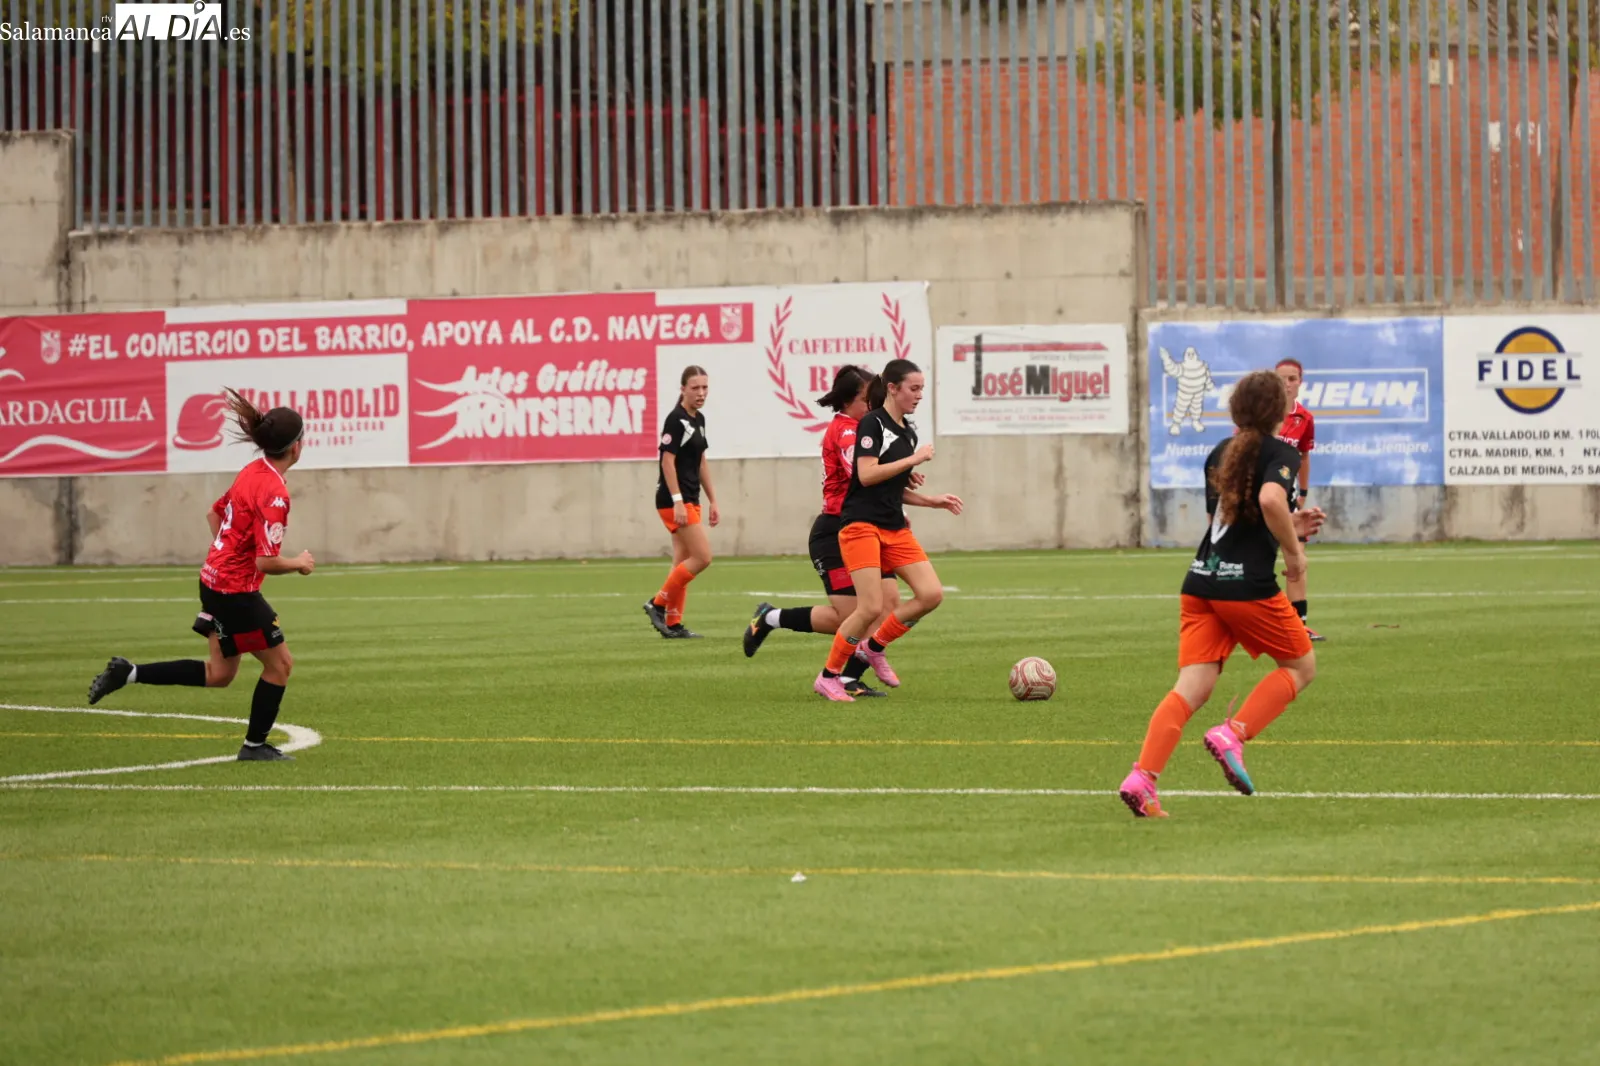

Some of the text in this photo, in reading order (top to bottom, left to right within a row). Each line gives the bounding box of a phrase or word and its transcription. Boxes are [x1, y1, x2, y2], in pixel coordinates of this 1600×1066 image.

[69, 313, 711, 360] #EL COMERCIO DEL BARRIO, APOYA AL C.D. NAVEGA
[788, 334, 888, 354] CAFETERÍA
[460, 358, 647, 394] Artes Gráficas
[1478, 359, 1580, 381] FIDEL
[1217, 380, 1419, 410] HELIN
[456, 394, 647, 439] MONTSERRAT
[1553, 430, 1574, 440] KM.
[1449, 448, 1482, 458] CTRA.
[1485, 447, 1532, 459] MADRID,
[1535, 447, 1556, 458] KM.
[1558, 447, 1565, 457] 1
[1449, 465, 1500, 477] CALZADA
[1503, 465, 1518, 476] DE
[1521, 465, 1568, 478] MEDINA,
[1571, 464, 1585, 475] 25
